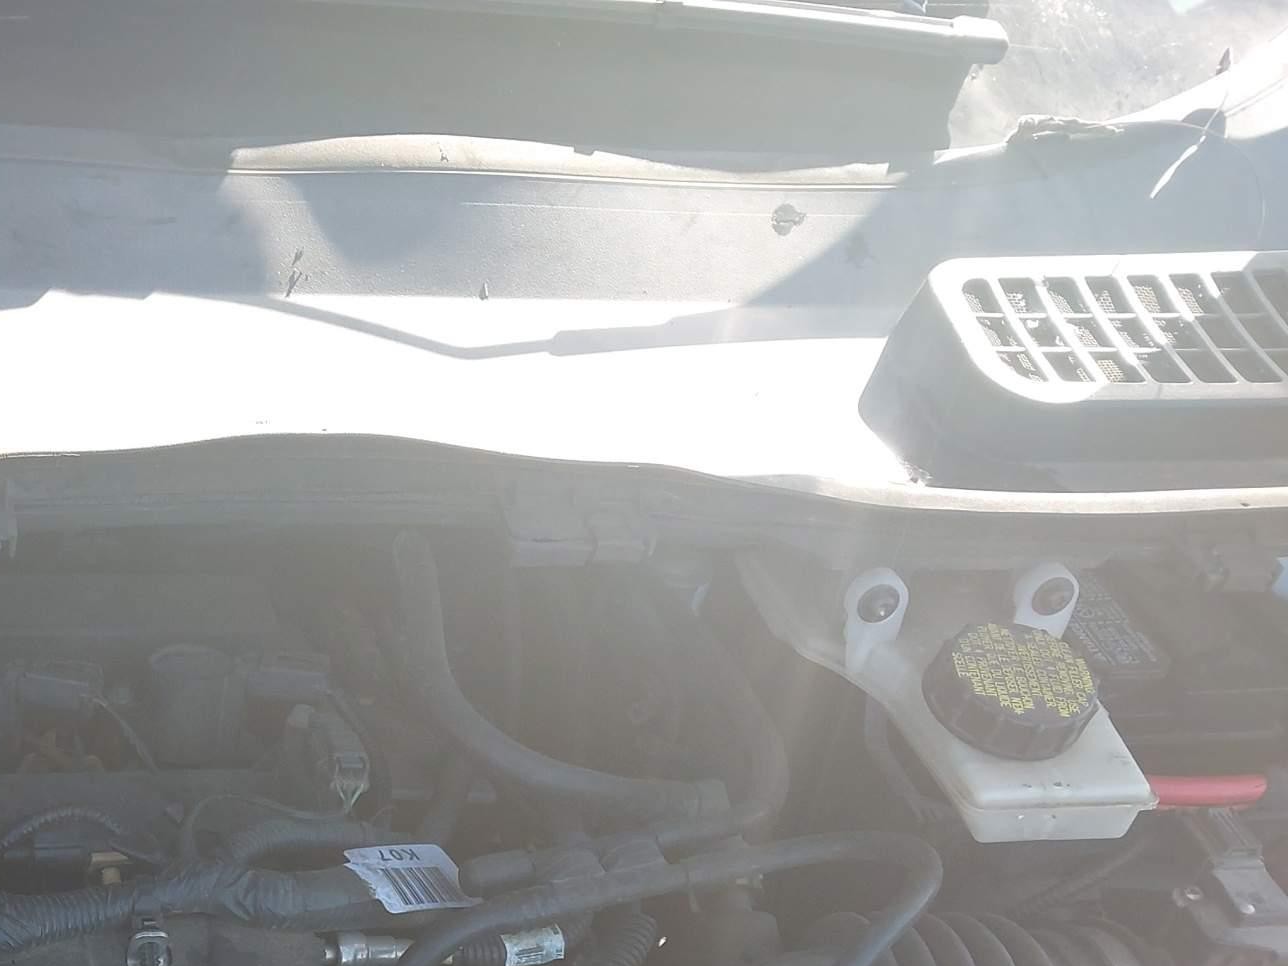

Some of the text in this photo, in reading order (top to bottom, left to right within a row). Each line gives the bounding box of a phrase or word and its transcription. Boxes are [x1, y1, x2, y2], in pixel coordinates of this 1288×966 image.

[963, 655, 987, 695] CONTENANT
[975, 656, 998, 696] PROVENANT
[991, 669, 1003, 678] DU
[1035, 669, 1057, 707] CONTAINER
[1059, 642, 1089, 706] CLEAN FILLER CAP
[993, 682, 1013, 708] LIQUIDE
[1014, 676, 1035, 708] BOUCHON
[1054, 696, 1071, 716] FROM
[1067, 700, 1081, 714] USE
[378, 848, 421, 862] K07
